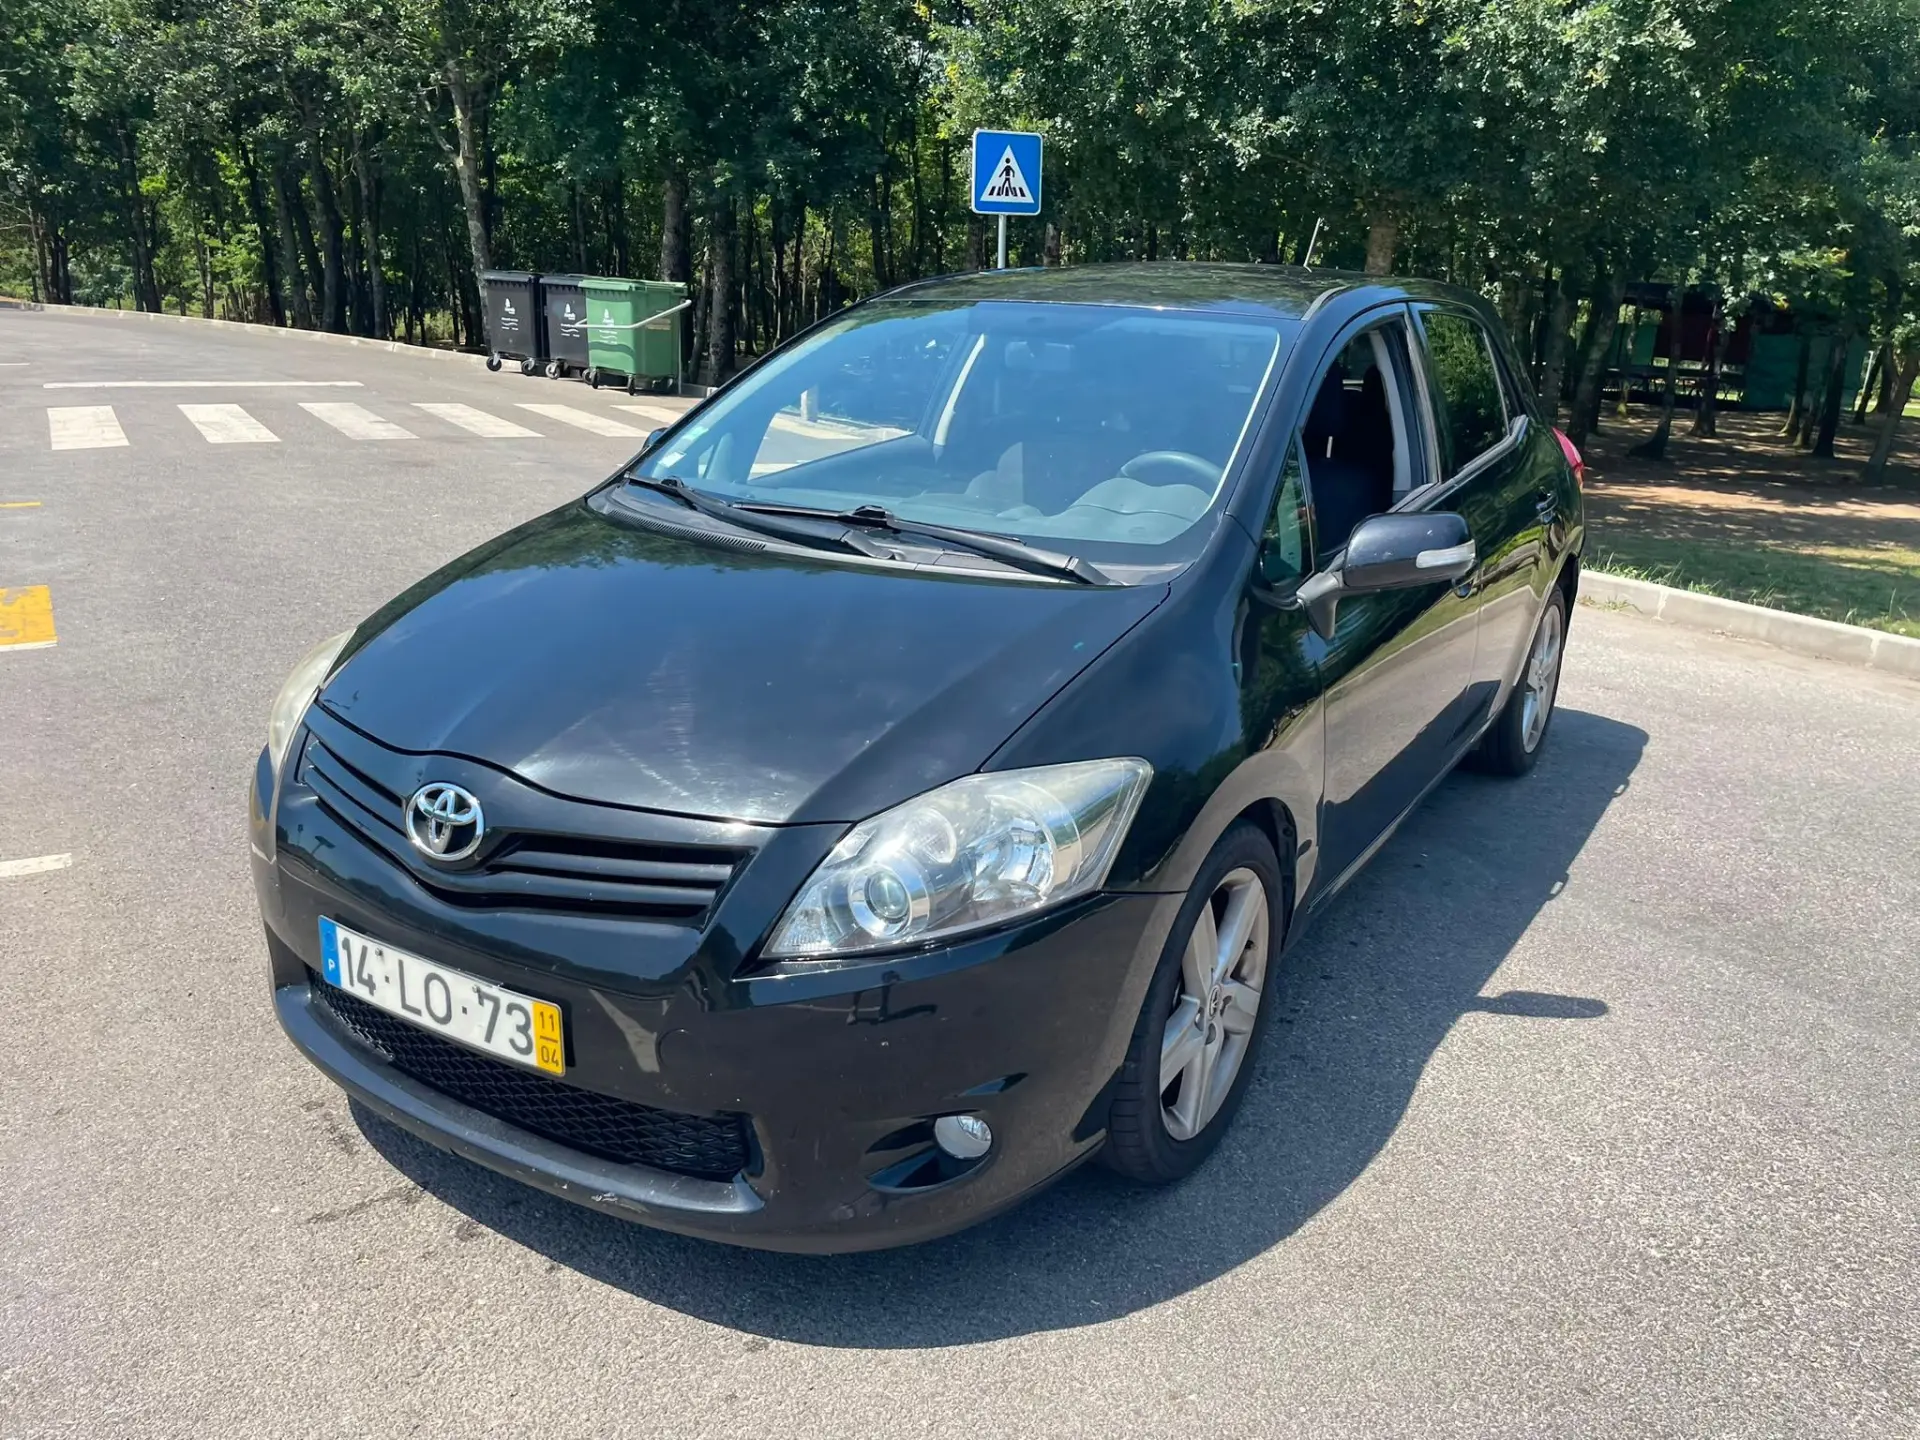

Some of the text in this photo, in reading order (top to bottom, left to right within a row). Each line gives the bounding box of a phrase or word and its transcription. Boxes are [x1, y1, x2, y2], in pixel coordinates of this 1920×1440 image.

[327, 958, 336, 971] P
[539, 1011, 555, 1032] 11
[540, 1045, 560, 1067] 04
